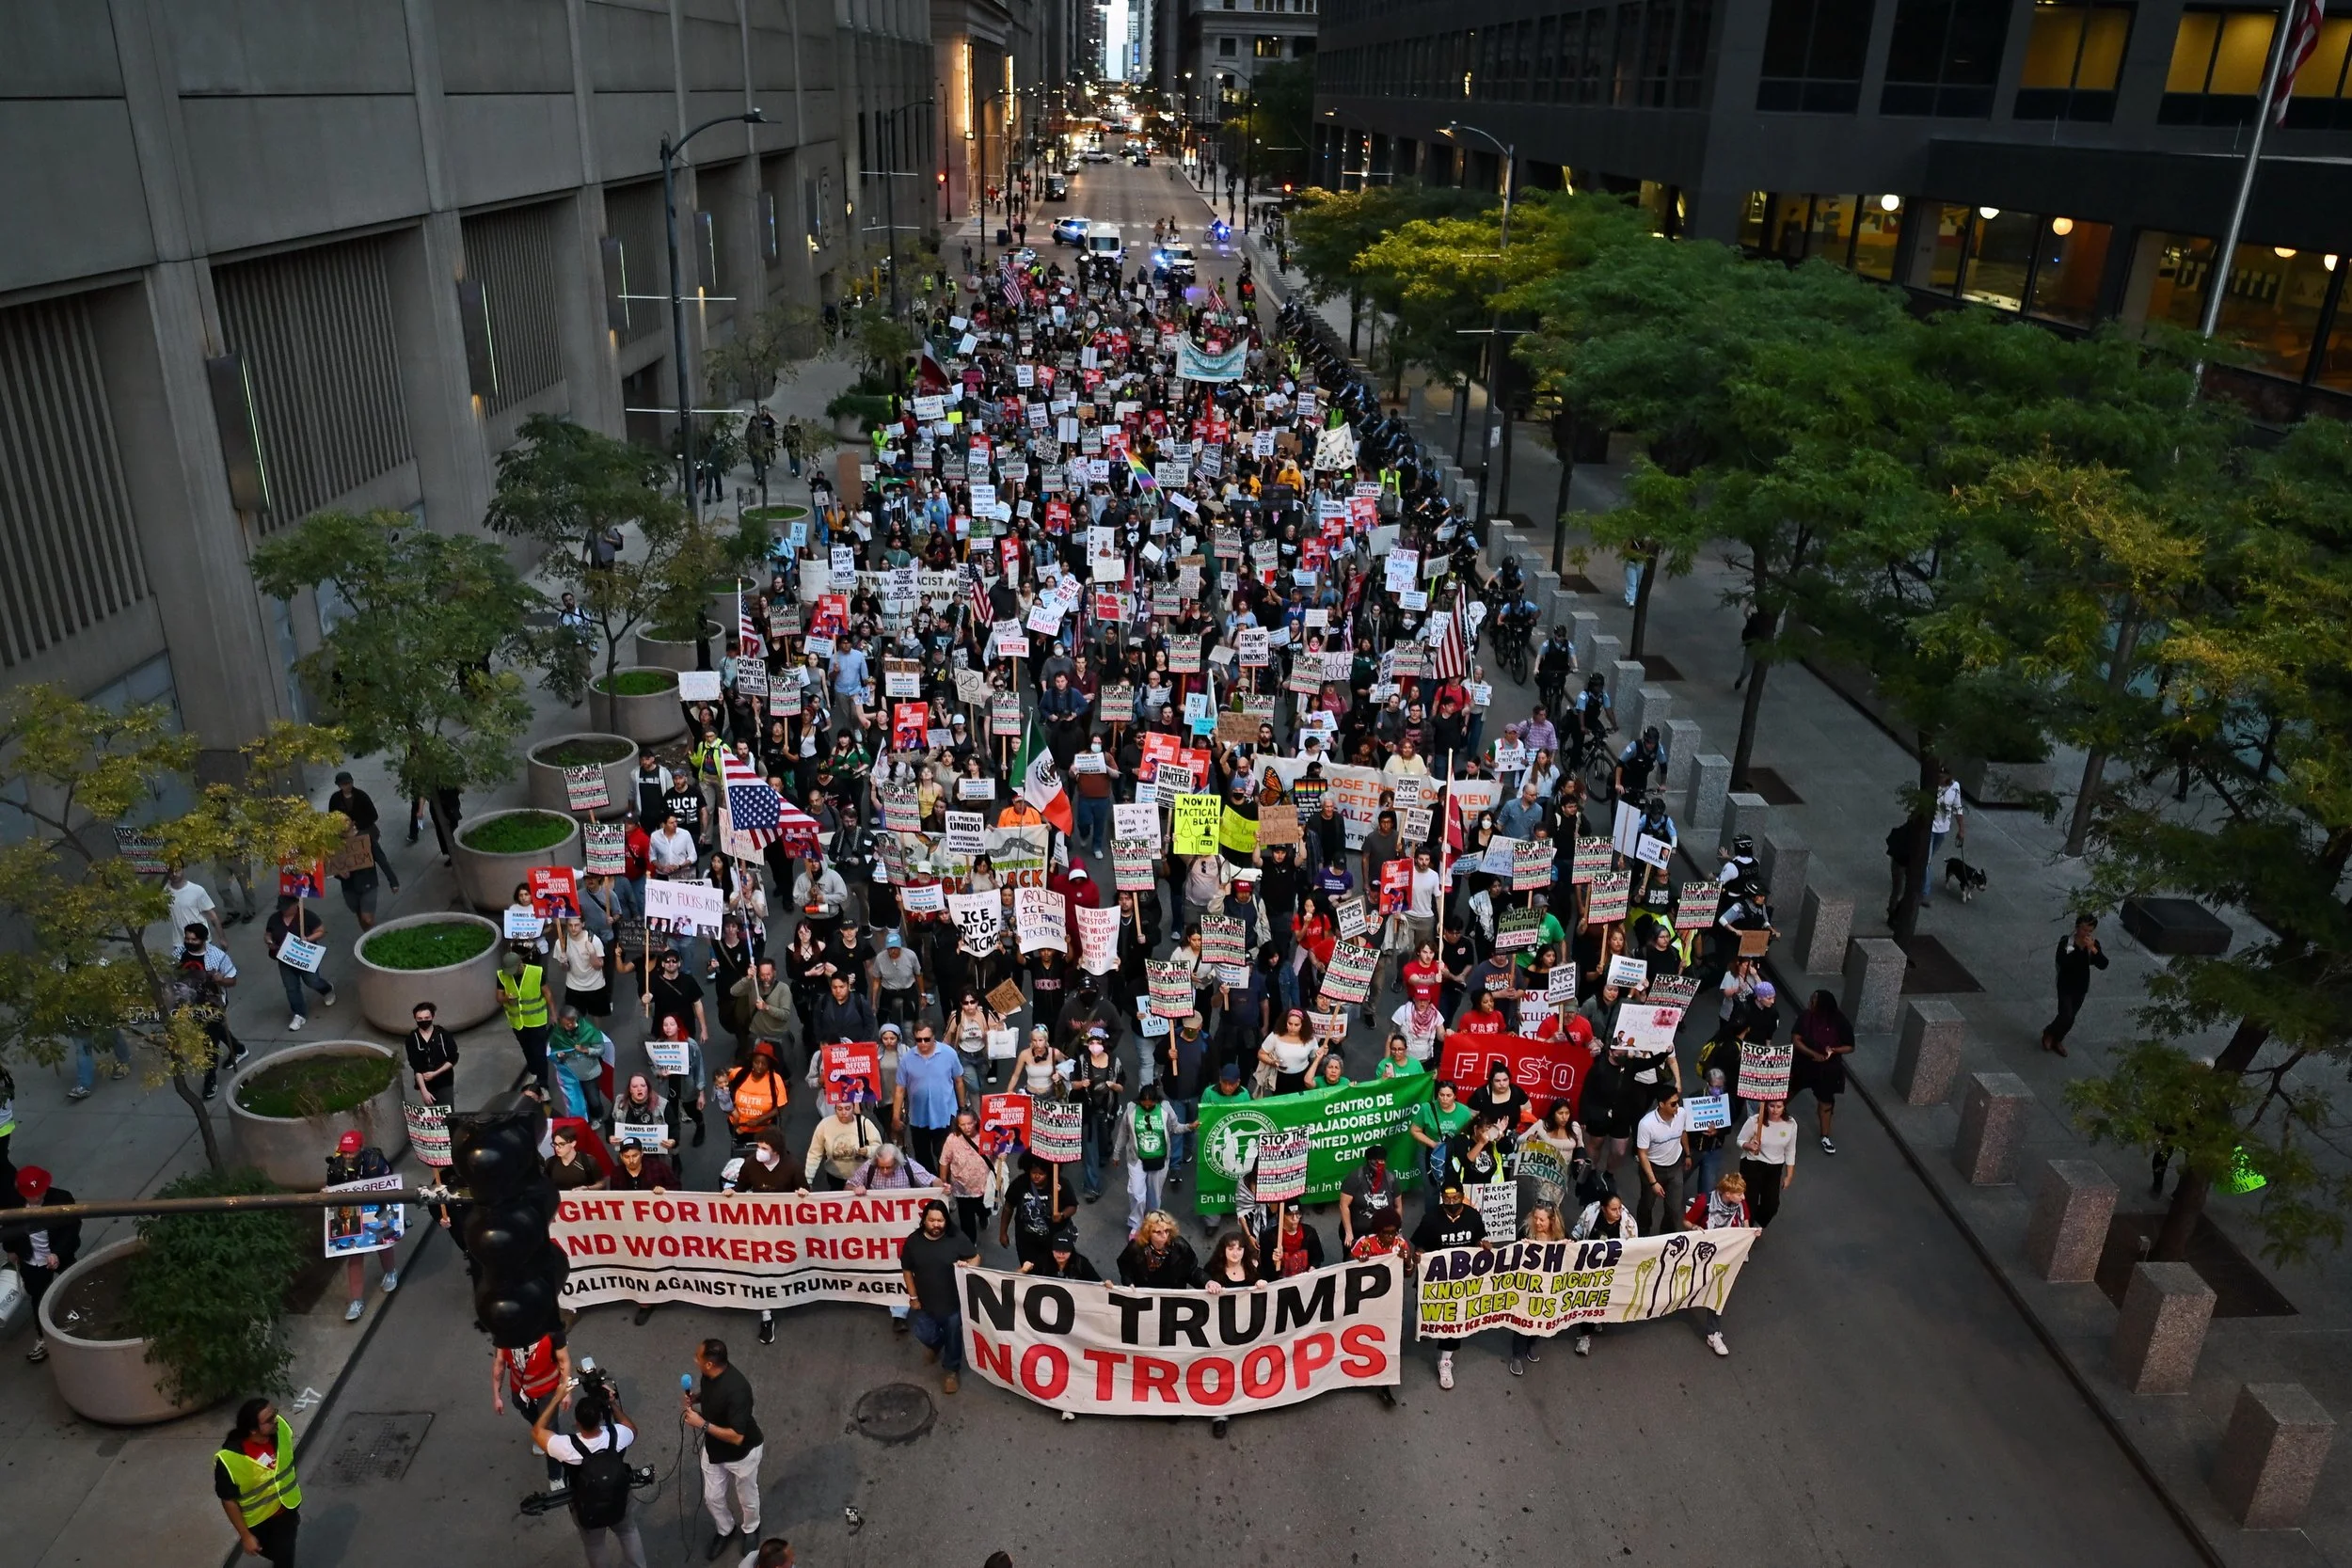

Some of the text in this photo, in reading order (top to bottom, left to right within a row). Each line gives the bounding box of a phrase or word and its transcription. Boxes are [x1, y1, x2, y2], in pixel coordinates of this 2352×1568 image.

[1030, 620, 1057, 632] TRUMP
[738, 658, 763, 669] POWER
[739, 669, 764, 677] WORKERS
[1159, 770, 1190, 783] UNITED
[1171, 767, 1190, 775] PEOPLE
[1183, 798, 1203, 806] NOW
[1177, 808, 1217, 816] TACTICAL
[949, 822, 980, 832] UNIDO
[1515, 839, 1551, 851] STOP THE
[1594, 871, 1630, 882] STOP THE
[1683, 882, 1704, 892] STOP
[646, 887, 723, 912] TRUMP FUCKS KIDS
[1021, 890, 1064, 908] ABOLISH
[961, 908, 990, 924] ICE
[1023, 906, 1045, 914] ICE
[1339, 909, 1362, 922] NO
[1019, 915, 1038, 927] KEEP
[1500, 911, 1540, 924] CHICAGO
[980, 918, 997, 933] OF
[1498, 923, 1538, 934] PALESTINE
[1024, 927, 1062, 940] TOGETHER
[1497, 931, 1536, 942] OCCUPATION
[1336, 942, 1378, 958] STOP THE
[282, 954, 310, 969] CHICAGO
[1147, 961, 1168, 971] STOP
[1620, 959, 1635, 968] HANDS
[1549, 967, 1575, 977] DECIMOS
[1549, 974, 1574, 985] NO
[1656, 974, 1699, 987] STOP THE
[1521, 990, 1538, 1002] NO
[1743, 1044, 1792, 1055] STOP THE
[739, 1096, 762, 1104] FAITH
[1325, 1094, 1393, 1116] CENTRO DE
[405, 1103, 449, 1116] STOP THE
[1693, 1118, 1724, 1130] CHICAGO
[1261, 1128, 1308, 1146] STOP THE
[1520, 1151, 1557, 1168] LABOR
[362, 1179, 398, 1191] GREAT
[1200, 1195, 1214, 1204] En
[1217, 1194, 1226, 1203] la
[632, 1201, 701, 1223] FOR
[1441, 1230, 1471, 1242] FRSO
[622, 1234, 798, 1264] WORKERS
[1424, 1241, 1623, 1282] ABOLISH ICE
[655, 1276, 737, 1296] AGAINST
[739, 1283, 778, 1299] THE
[781, 1277, 852, 1296] TRUMP
[1422, 1268, 1614, 1300] KNOW YOUR RIGHTS
[966, 1263, 1391, 1348] NO TRUMP
[1420, 1289, 1611, 1323] WE KEEP US SAFE
[1421, 1323, 1463, 1335] REPORT
[1465, 1318, 1480, 1332] ICE
[972, 1324, 1388, 1406] NO TROOPS
